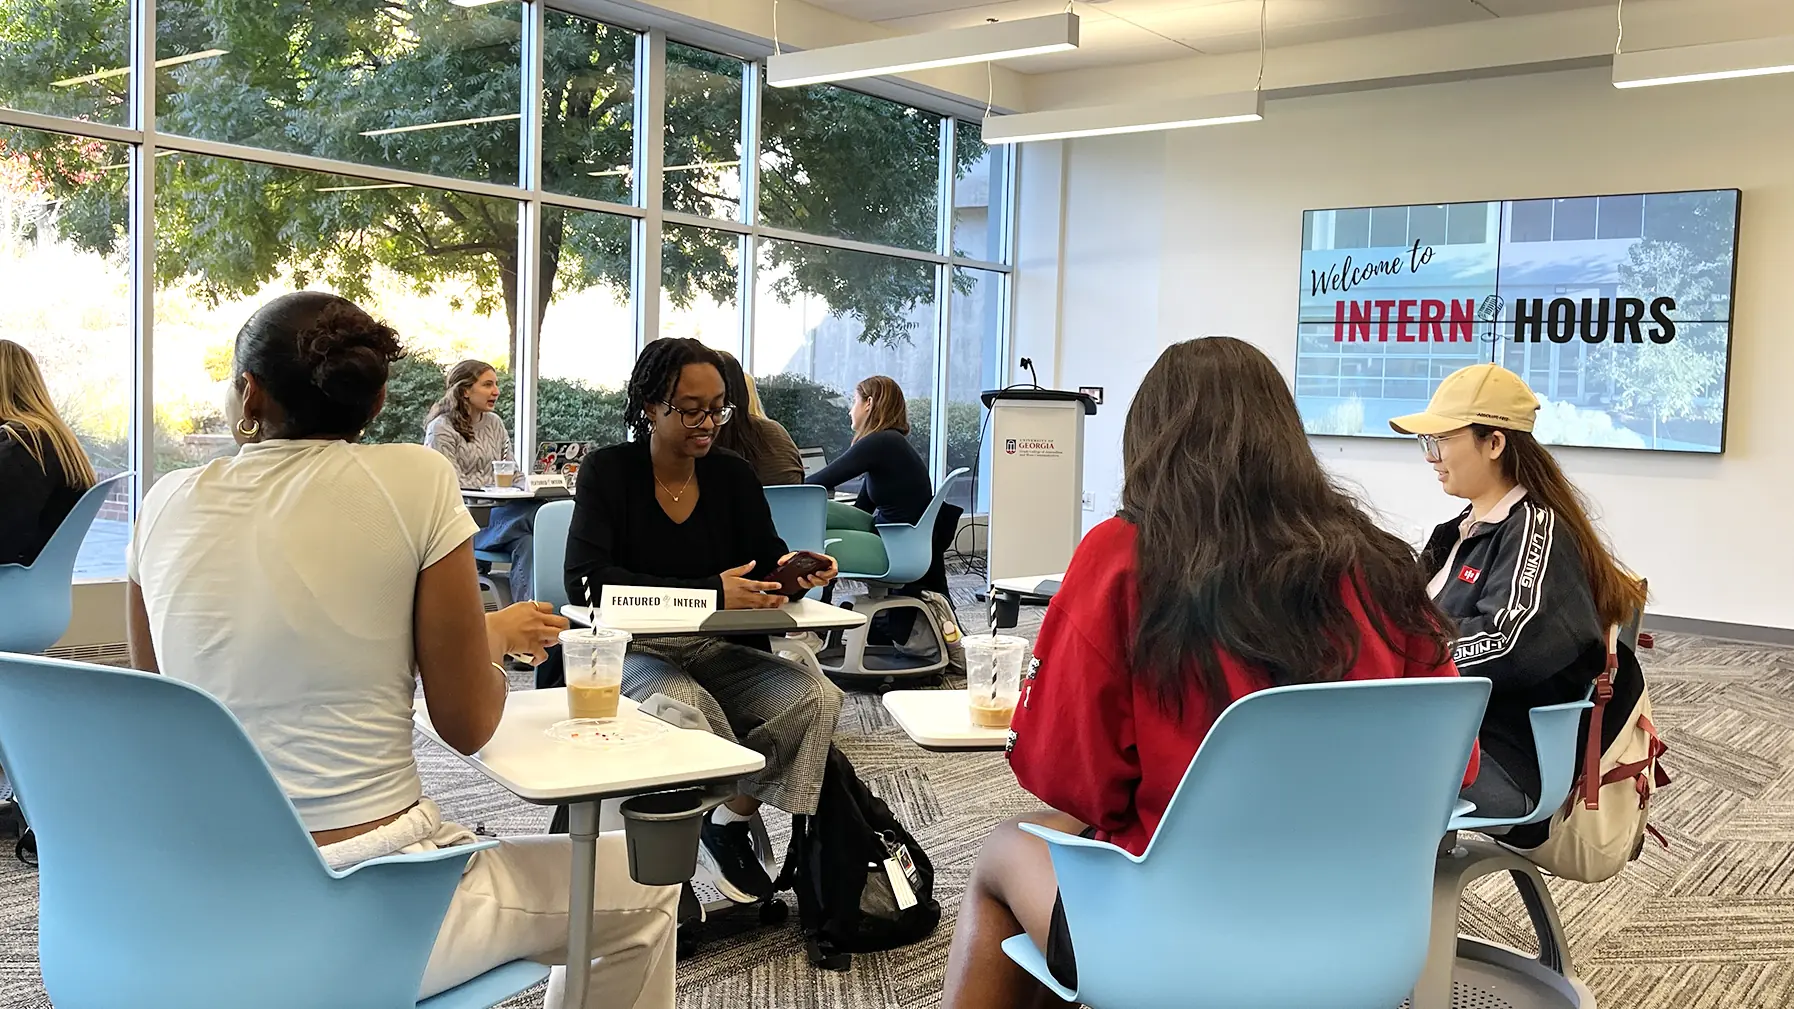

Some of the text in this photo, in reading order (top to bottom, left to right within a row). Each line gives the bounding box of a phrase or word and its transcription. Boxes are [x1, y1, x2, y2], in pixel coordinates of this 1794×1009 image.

[1312, 239, 1436, 296] Welcome to
[1334, 297, 1676, 344] INTERN HOURS
[1521, 533, 1544, 589] LI-NING
[612, 596, 707, 608] FEATURED INTERN
